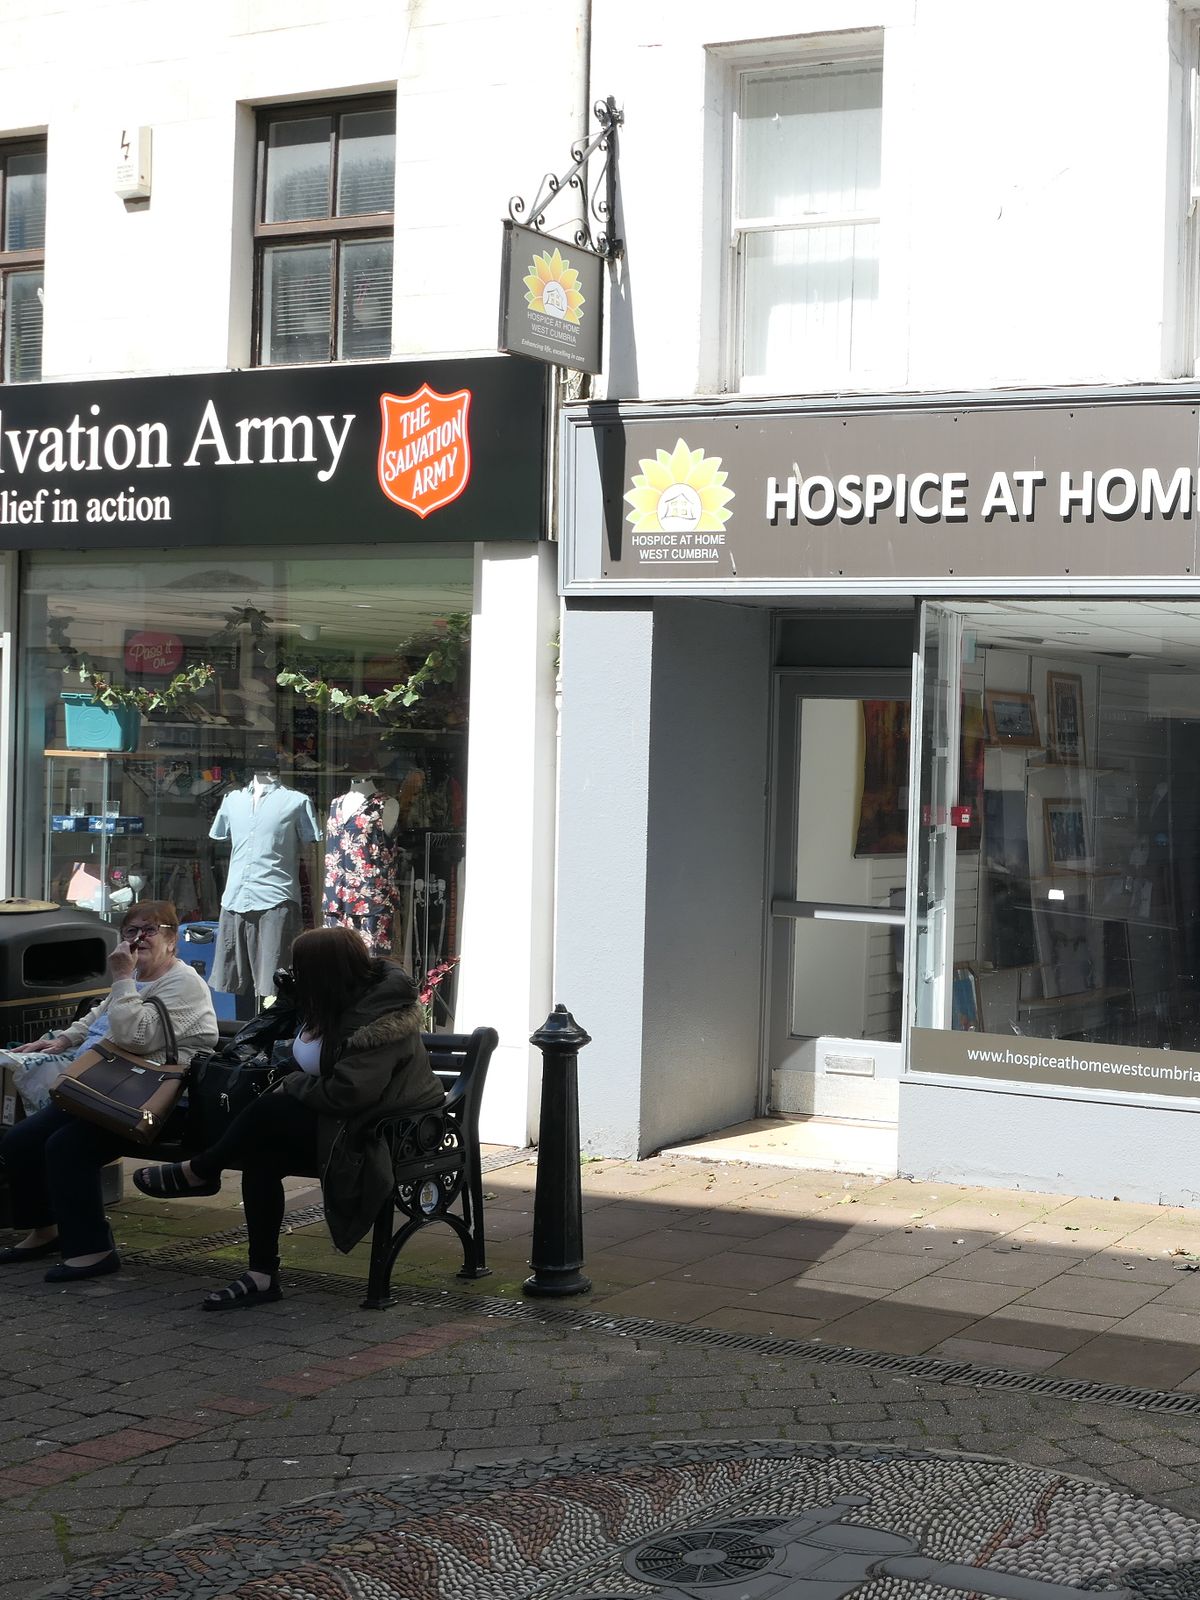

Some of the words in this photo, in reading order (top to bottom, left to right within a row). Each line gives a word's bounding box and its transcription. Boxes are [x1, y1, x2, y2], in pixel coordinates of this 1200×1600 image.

[528, 312, 554, 327] HOSPICE
[563, 324, 580, 334] HOME
[531, 323, 549, 335] WEST
[549, 329, 577, 344] CUMBRIA
[400, 402, 430, 439] THE
[184, 400, 356, 482] Army
[384, 409, 462, 482] SALVATION
[411, 447, 458, 500] ARMY
[0, 489, 49, 524] lief
[52, 489, 79, 522] in
[86, 487, 171, 522] action
[767, 473, 966, 520] HOSPICE
[982, 470, 1044, 517] AT
[632, 535, 678, 546] HOSPICE
[680, 535, 693, 545] AT
[695, 534, 726, 545] HOME
[639, 549, 669, 559] WEST
[671, 548, 719, 559] CUMBRIA
[39, 1005, 78, 1018] LITT
